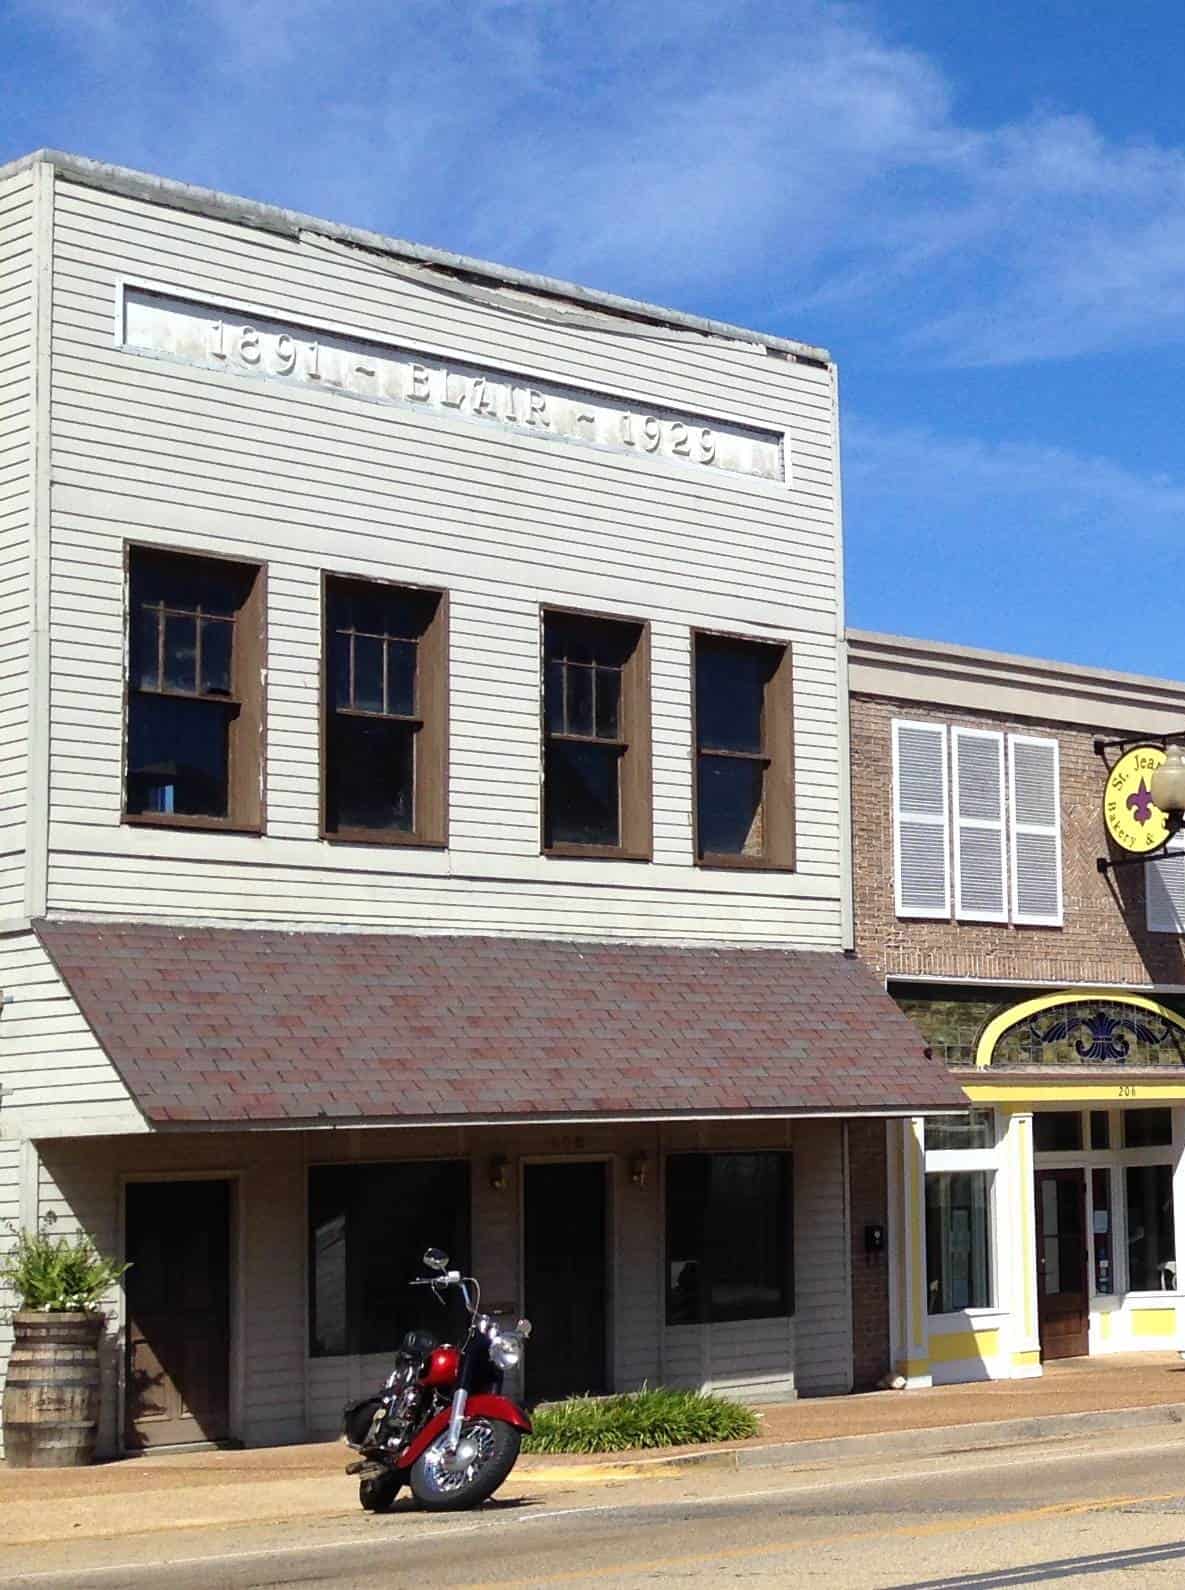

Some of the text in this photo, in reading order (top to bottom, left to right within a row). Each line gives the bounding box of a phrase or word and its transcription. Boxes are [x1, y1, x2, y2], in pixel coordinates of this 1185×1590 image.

[207, 320, 322, 379] 1891
[404, 362, 551, 427] BLAIR
[620, 411, 717, 465] 1929
[1112, 771, 1129, 791] St.
[1107, 801, 1137, 849] Bakery
[1145, 833, 1155, 846] &
